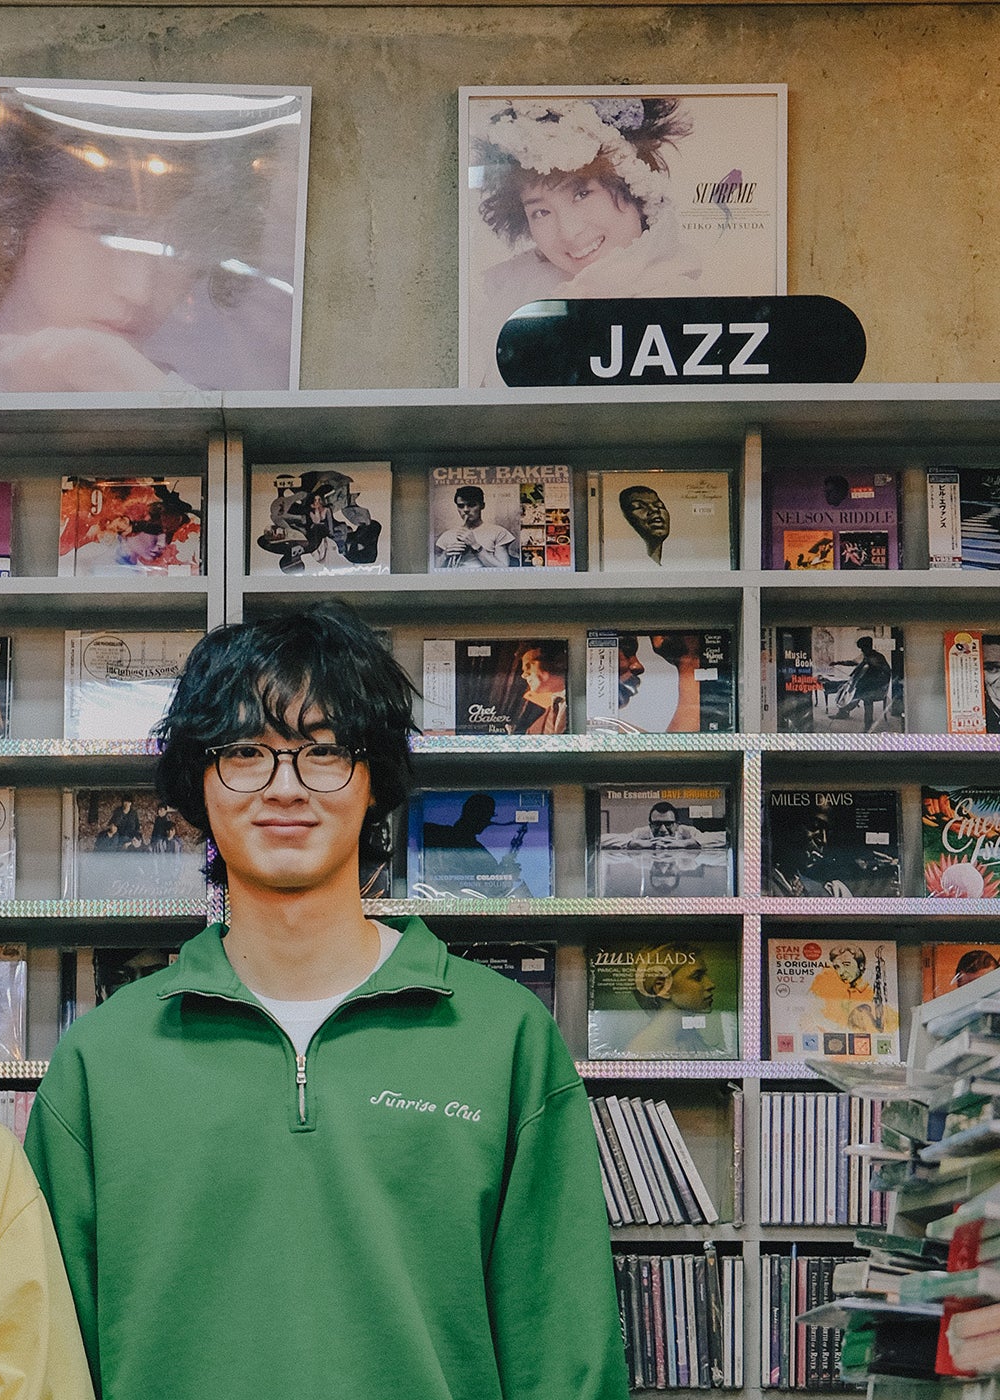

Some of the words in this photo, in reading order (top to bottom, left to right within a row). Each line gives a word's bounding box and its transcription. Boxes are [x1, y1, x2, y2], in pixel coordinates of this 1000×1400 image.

[692, 183, 757, 204] SUPREME
[682, 223, 713, 231] SEIKO
[717, 222, 765, 231] MATSUDA
[589, 321, 770, 379] JAZZ
[432, 466, 489, 480] CHET
[495, 465, 570, 479] BAKER
[938, 484, 947, 528] ビル・エヴァンス
[776, 511, 834, 524] NELSON
[839, 510, 894, 524] RIDDLE
[785, 650, 807, 659] Music
[795, 659, 813, 668] Book
[468, 704, 497, 715] Chet
[606, 790, 622, 799] The
[623, 790, 660, 799] Essential
[661, 789, 681, 799] DAVE
[771, 792, 811, 806] MILES
[815, 792, 854, 806] DAVIS
[775, 945, 800, 954] STAN
[626, 952, 696, 965] BALLADS
[776, 953, 800, 961] GETZ
[776, 960, 782, 968] 5
[784, 960, 831, 969] ORIGINAL
[776, 968, 815, 976] ALBUMS
[369, 1090, 437, 1113] Sunrise
[444, 1101, 481, 1122] Club
[810, 1352, 818, 1369] RIVER
[822, 1352, 830, 1369] RIVER
[834, 1352, 842, 1369] RIVER
